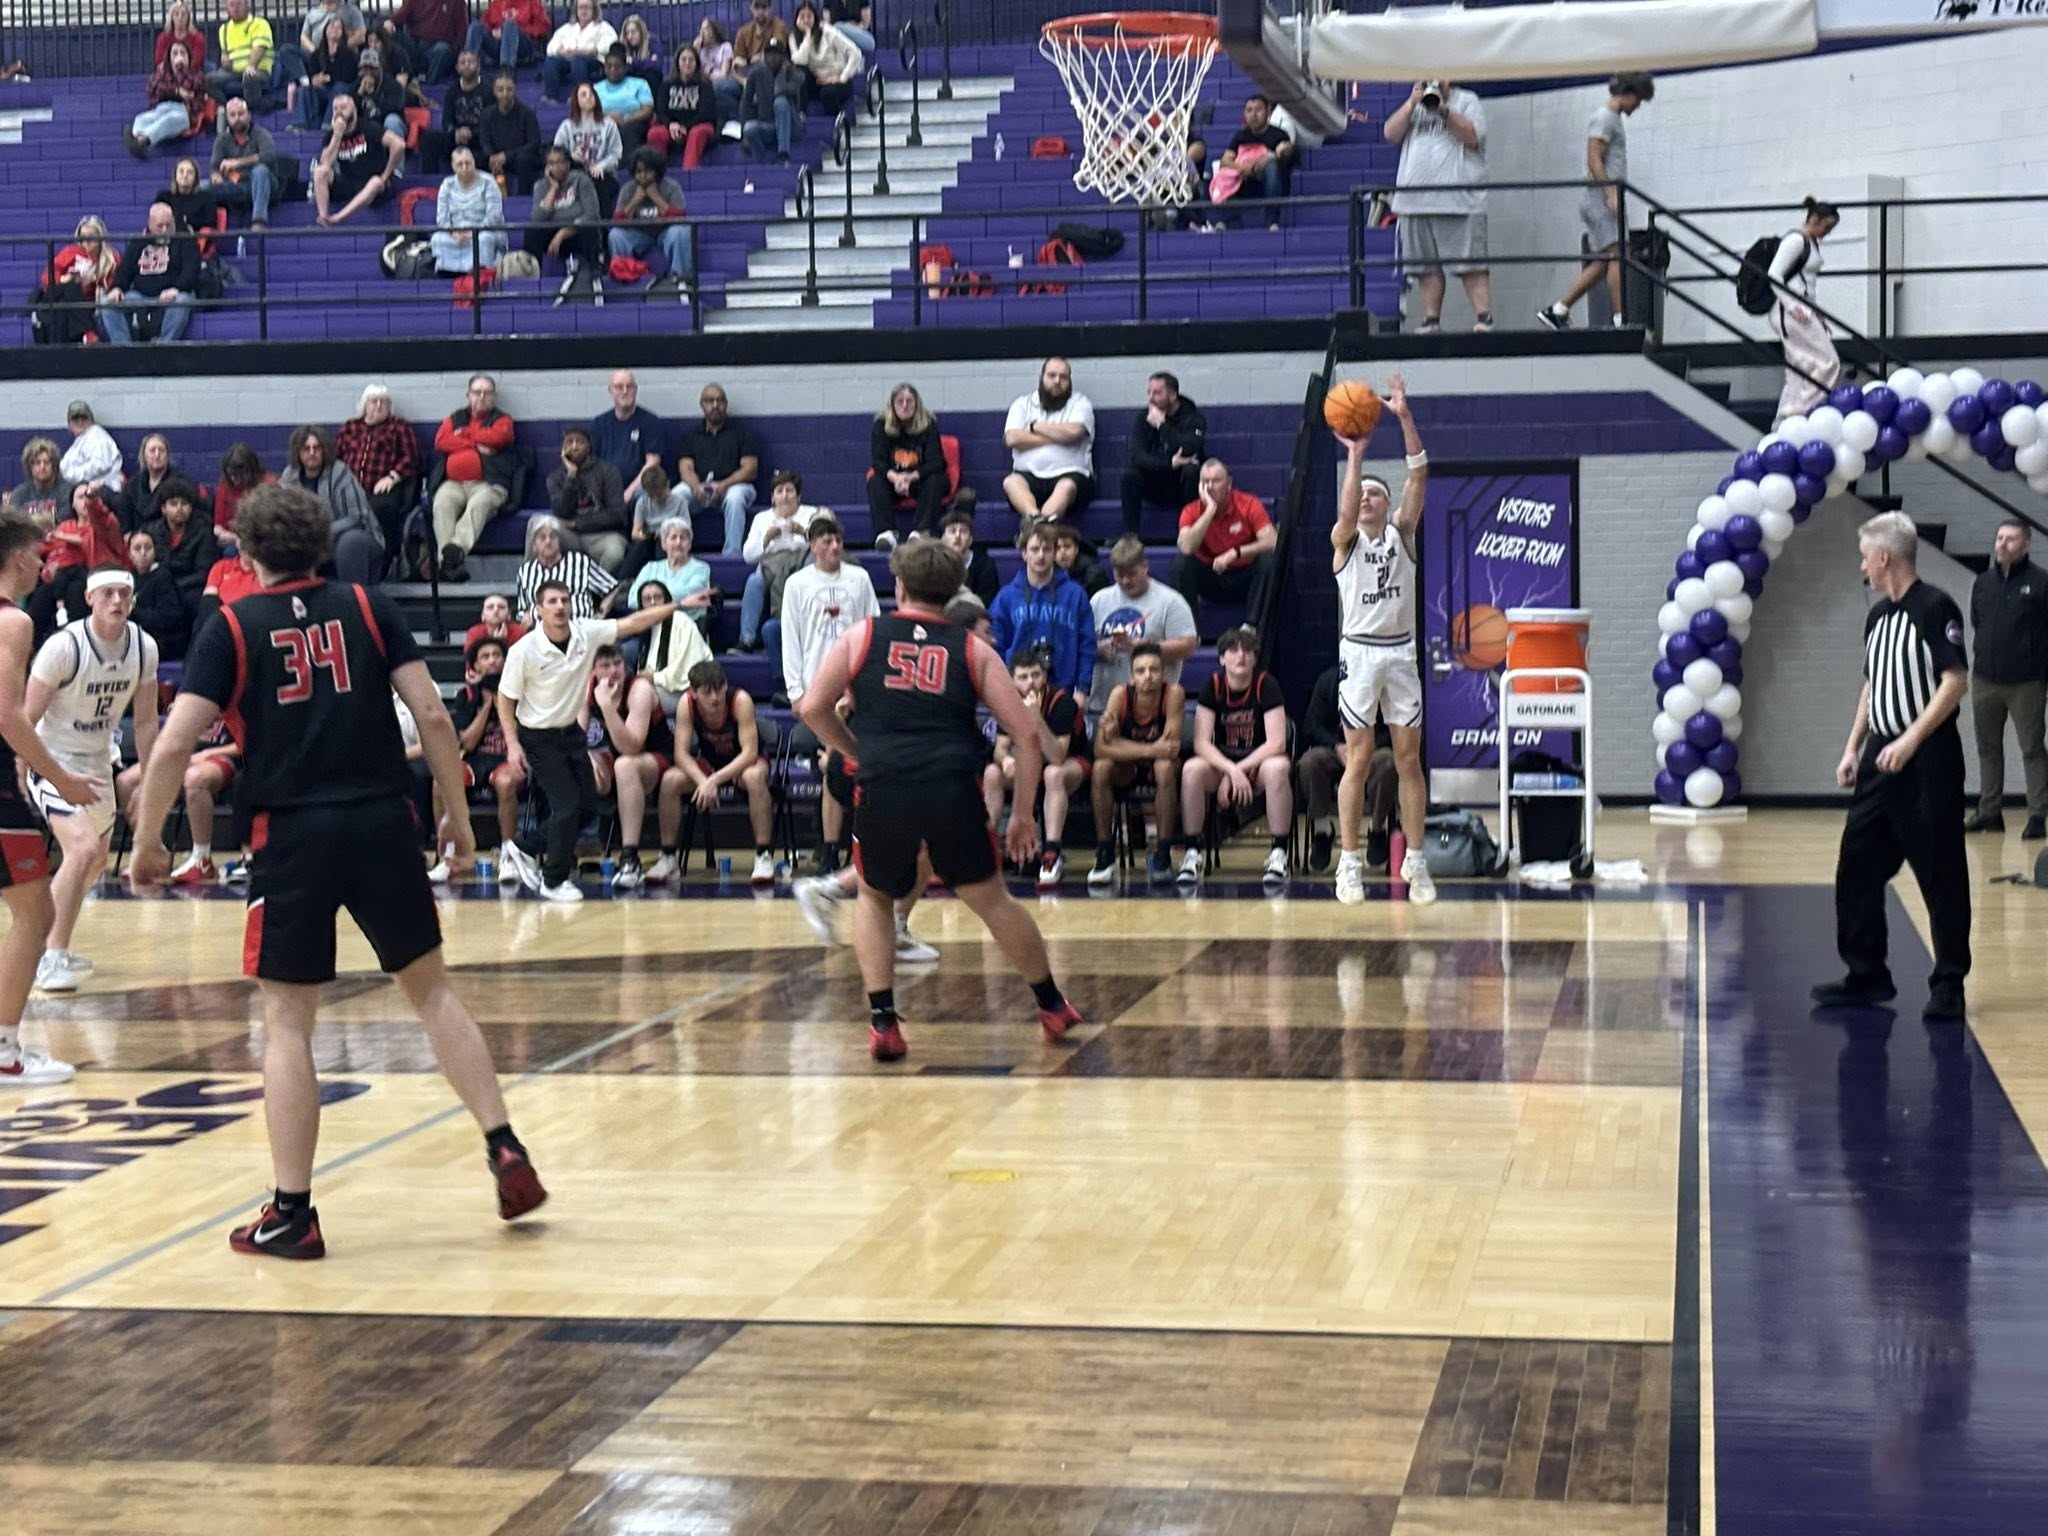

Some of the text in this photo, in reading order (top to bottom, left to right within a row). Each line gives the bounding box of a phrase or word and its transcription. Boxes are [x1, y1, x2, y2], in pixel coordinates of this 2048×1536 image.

[1496, 496, 1556, 529] VISITORS
[1475, 530, 1566, 569] LOCKER ROOM
[270, 618, 352, 705] 34
[883, 640, 949, 695] 50
[94, 696, 114, 718] 12
[1516, 703, 1576, 716] GATORADE
[1513, 729, 1542, 746] ON
